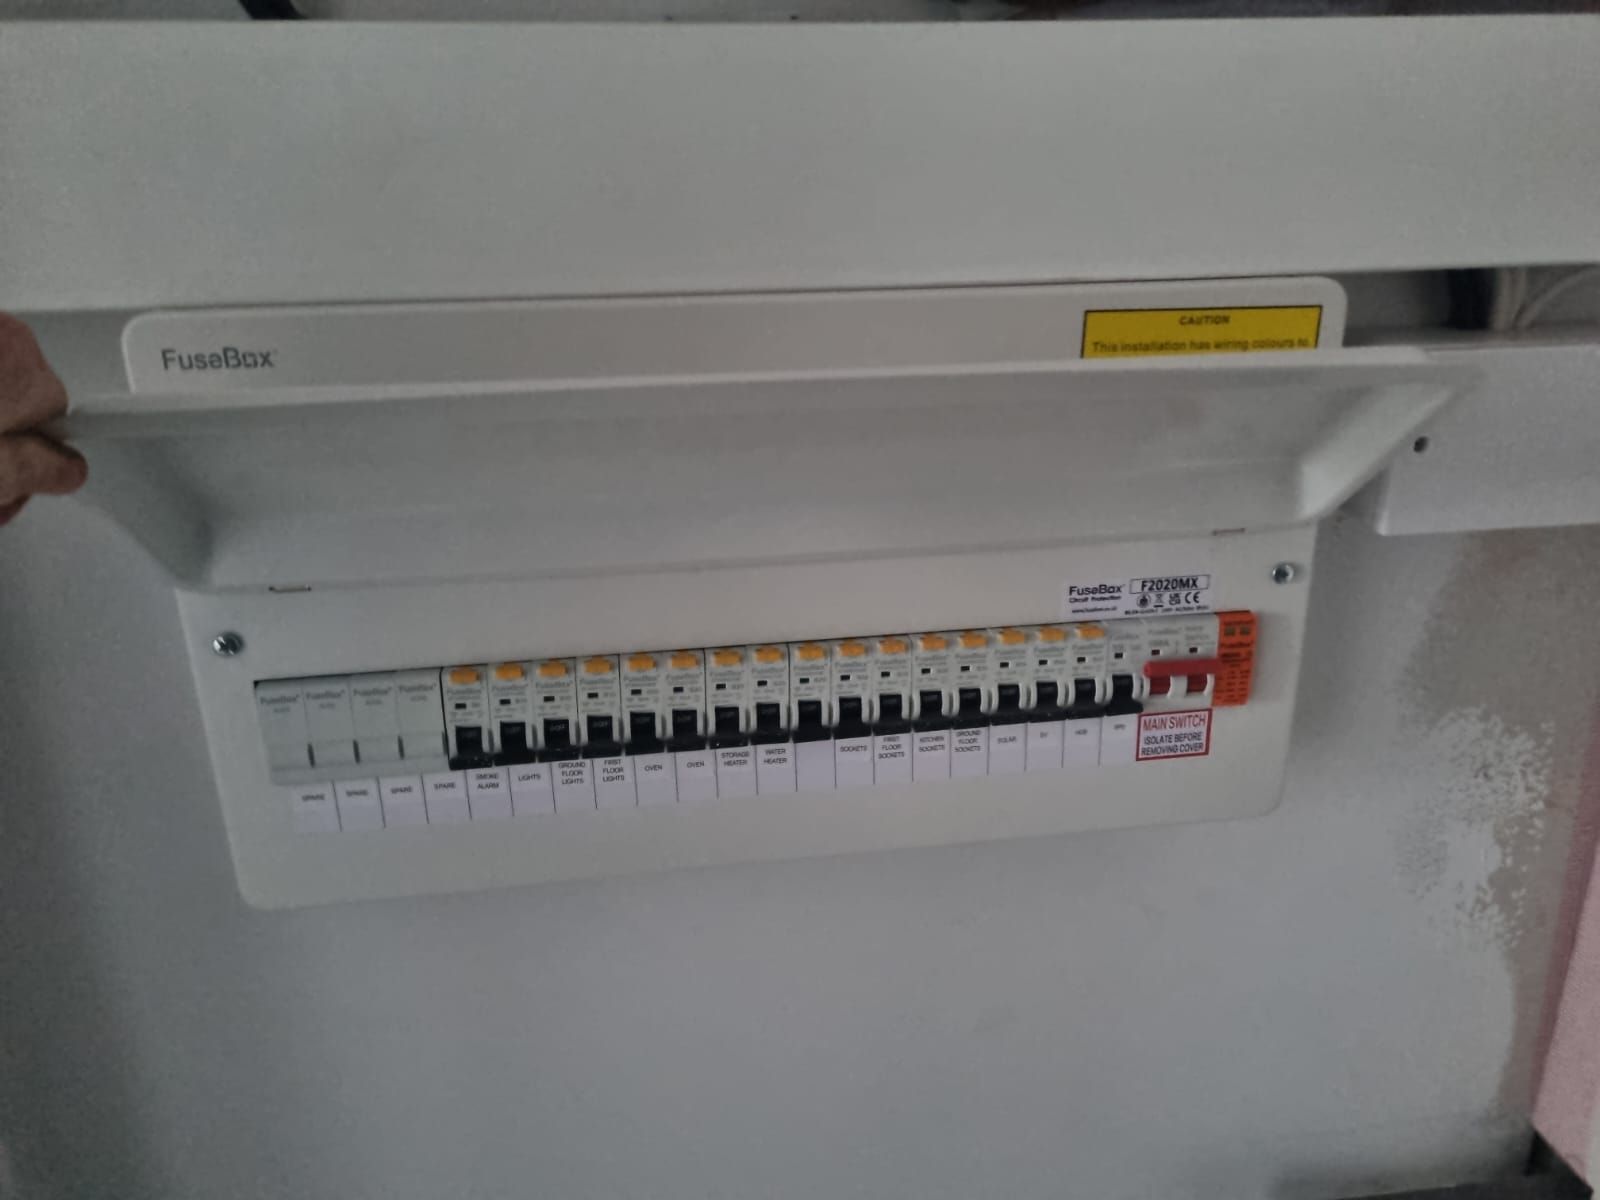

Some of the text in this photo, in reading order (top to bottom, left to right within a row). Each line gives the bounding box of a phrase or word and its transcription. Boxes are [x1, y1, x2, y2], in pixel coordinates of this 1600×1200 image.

[1178, 314, 1231, 326] CAUTION
[1093, 341, 1118, 353] This
[1121, 340, 1186, 352] installation
[1189, 339, 1211, 351] has
[1214, 339, 1249, 352] wiring
[1252, 338, 1296, 349] colours
[161, 346, 275, 371] FuseBox
[1141, 577, 1199, 592] F2020MX
[1069, 584, 1123, 596] FuseBox
[1143, 714, 1206, 731] MAIN SWITCH
[1144, 731, 1203, 745] ISOLATE BEFORE
[1141, 742, 1204, 756] REMOVING COVER
[558, 761, 585, 769] GROUND
[687, 760, 705, 768] OVEN
[763, 757, 787, 765] HEATER
[603, 767, 624, 775] FLOOR
[644, 764, 663, 772] OVEN
[518, 774, 541, 783] LIGHTS
[602, 774, 625, 783] LIGHTS
[477, 782, 500, 790] ALARM
